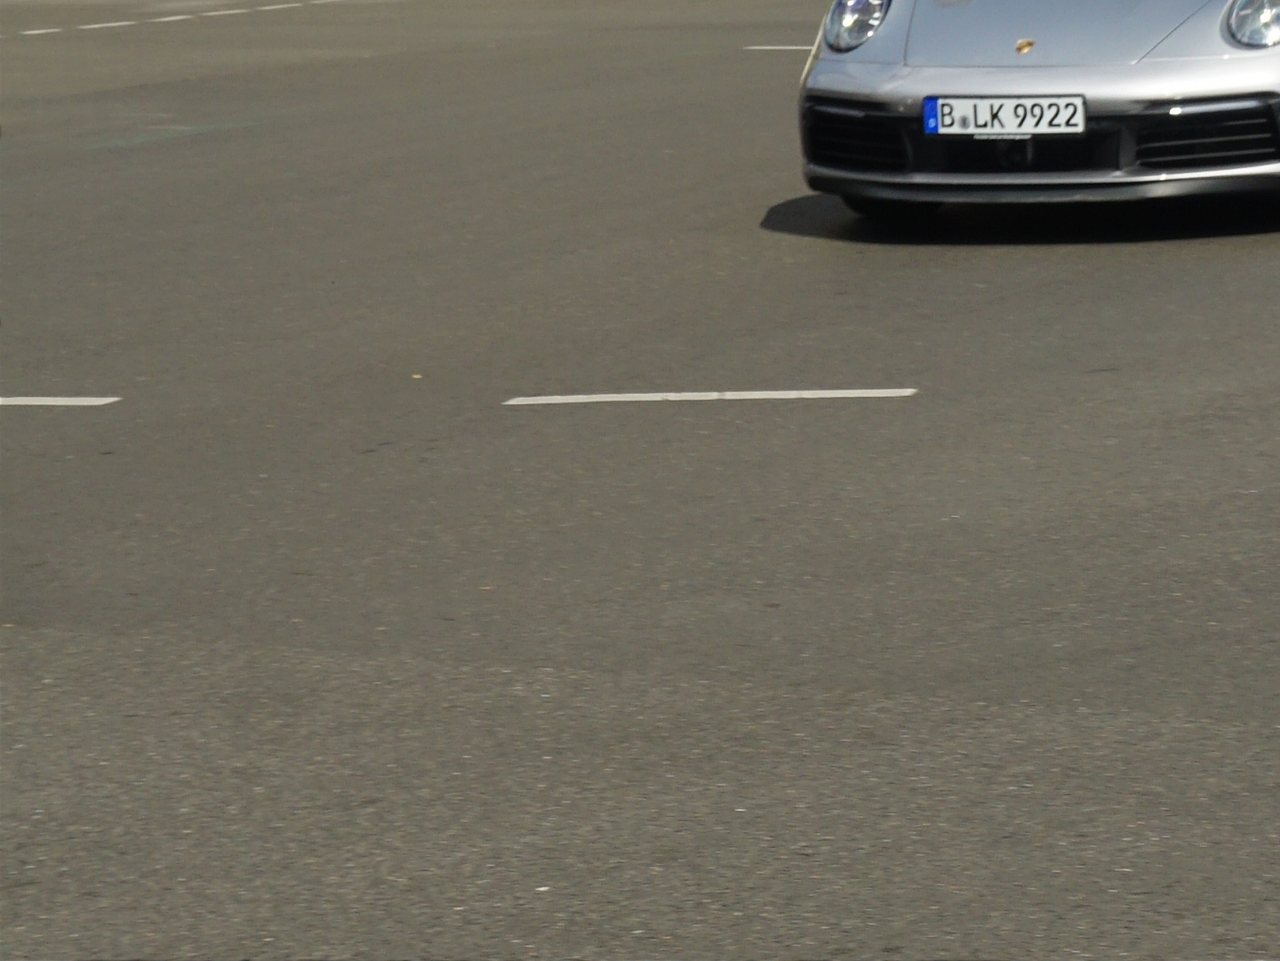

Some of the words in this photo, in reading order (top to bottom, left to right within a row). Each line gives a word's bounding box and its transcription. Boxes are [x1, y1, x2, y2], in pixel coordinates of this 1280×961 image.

[939, 103, 955, 128] B
[973, 103, 1005, 128] LK
[1013, 102, 1079, 128] 9922
